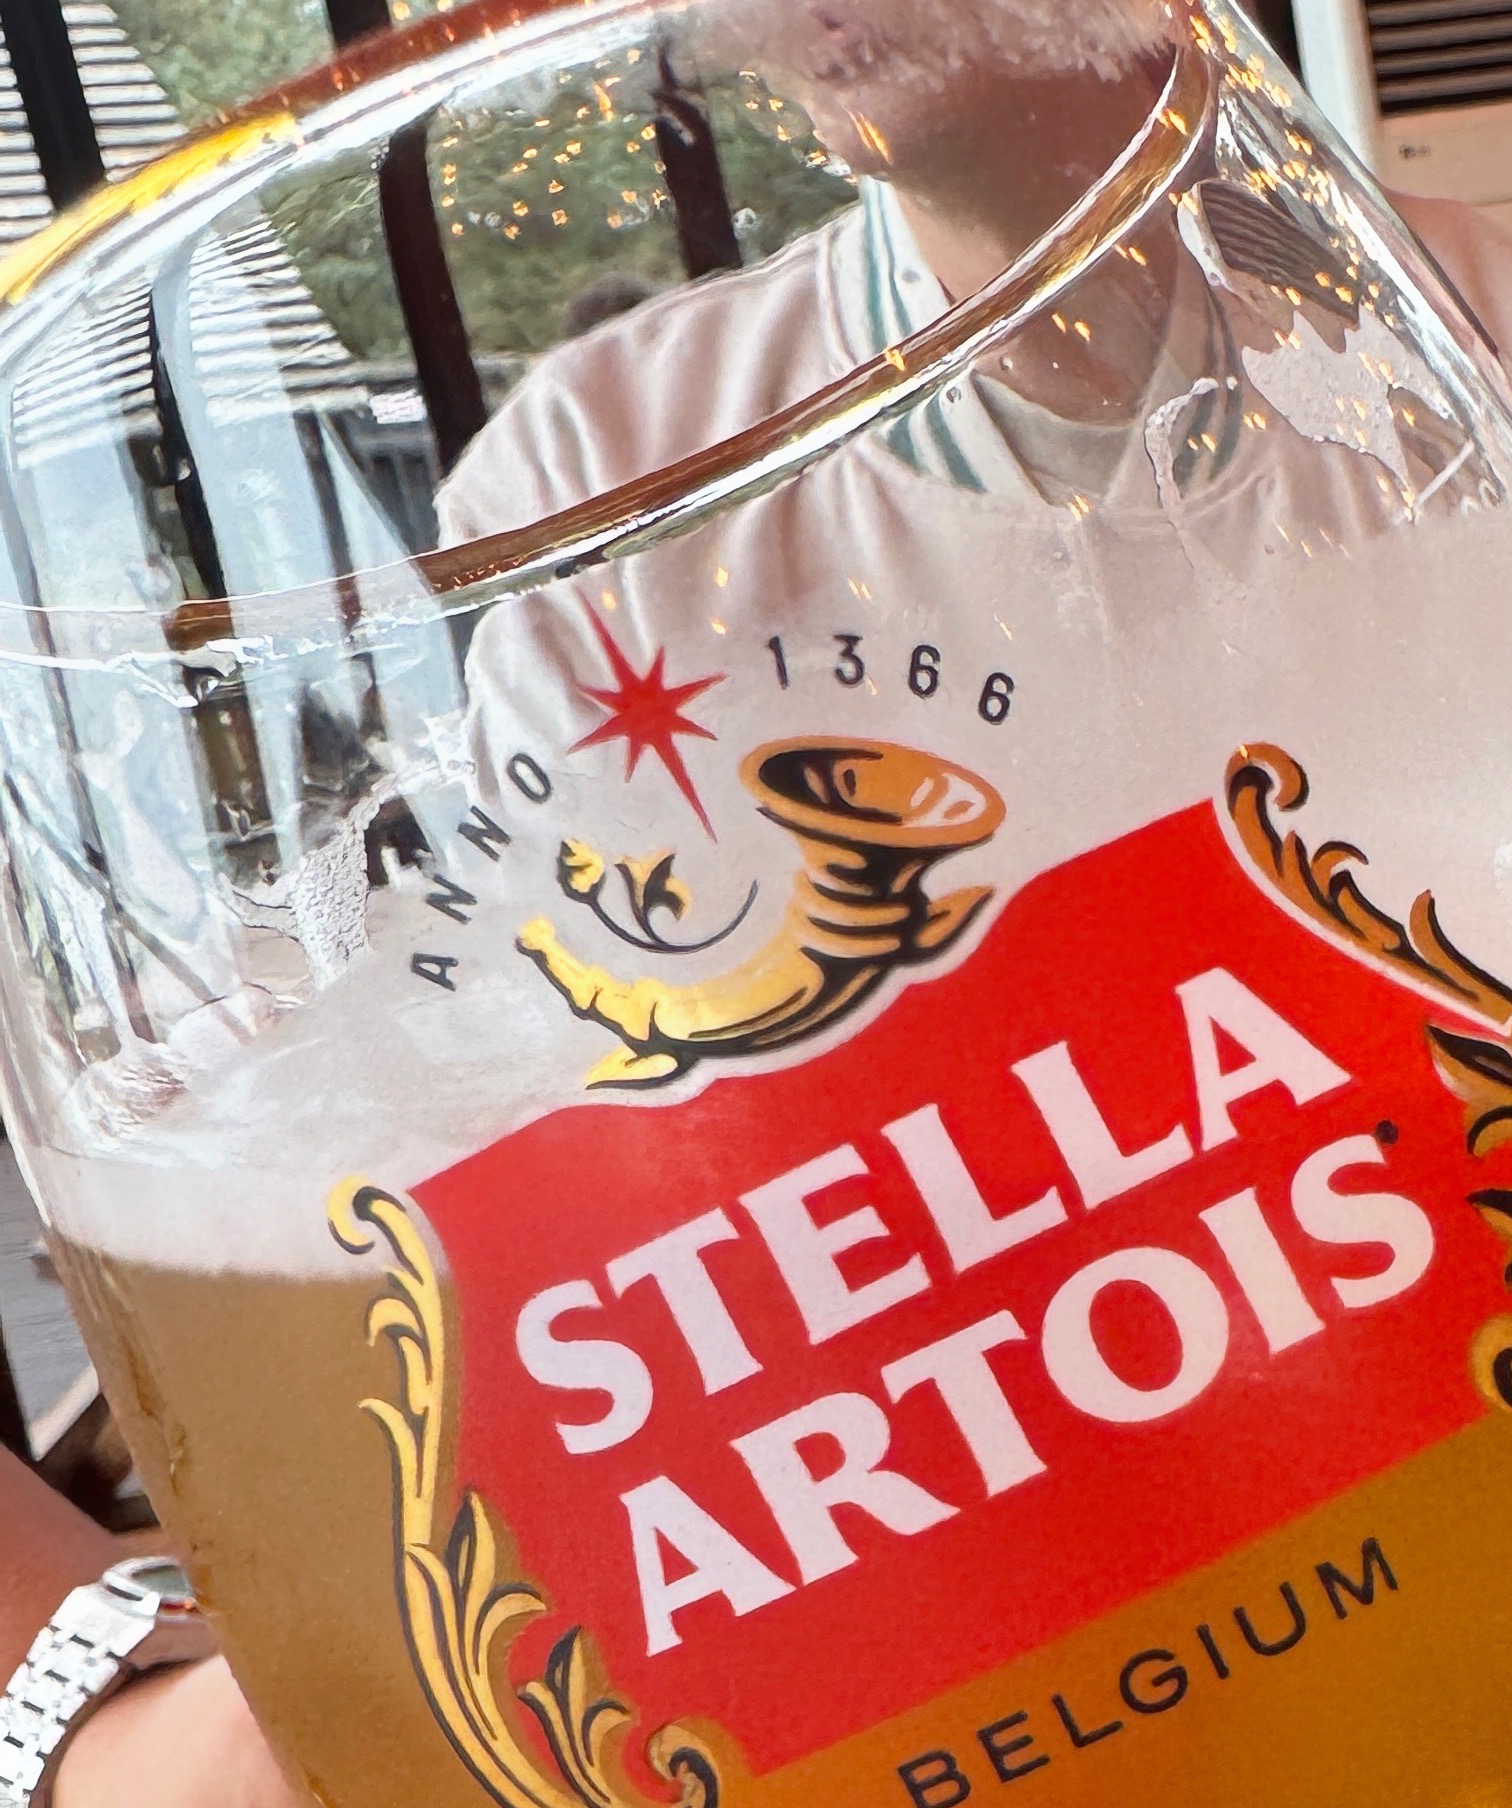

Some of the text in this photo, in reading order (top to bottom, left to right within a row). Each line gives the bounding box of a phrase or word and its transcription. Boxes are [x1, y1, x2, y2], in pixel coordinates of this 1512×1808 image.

[411, 633, 1016, 992] ANNO 1366
[514, 967, 1352, 1455] STELLA
[620, 1133, 1435, 1657] ARTOIS
